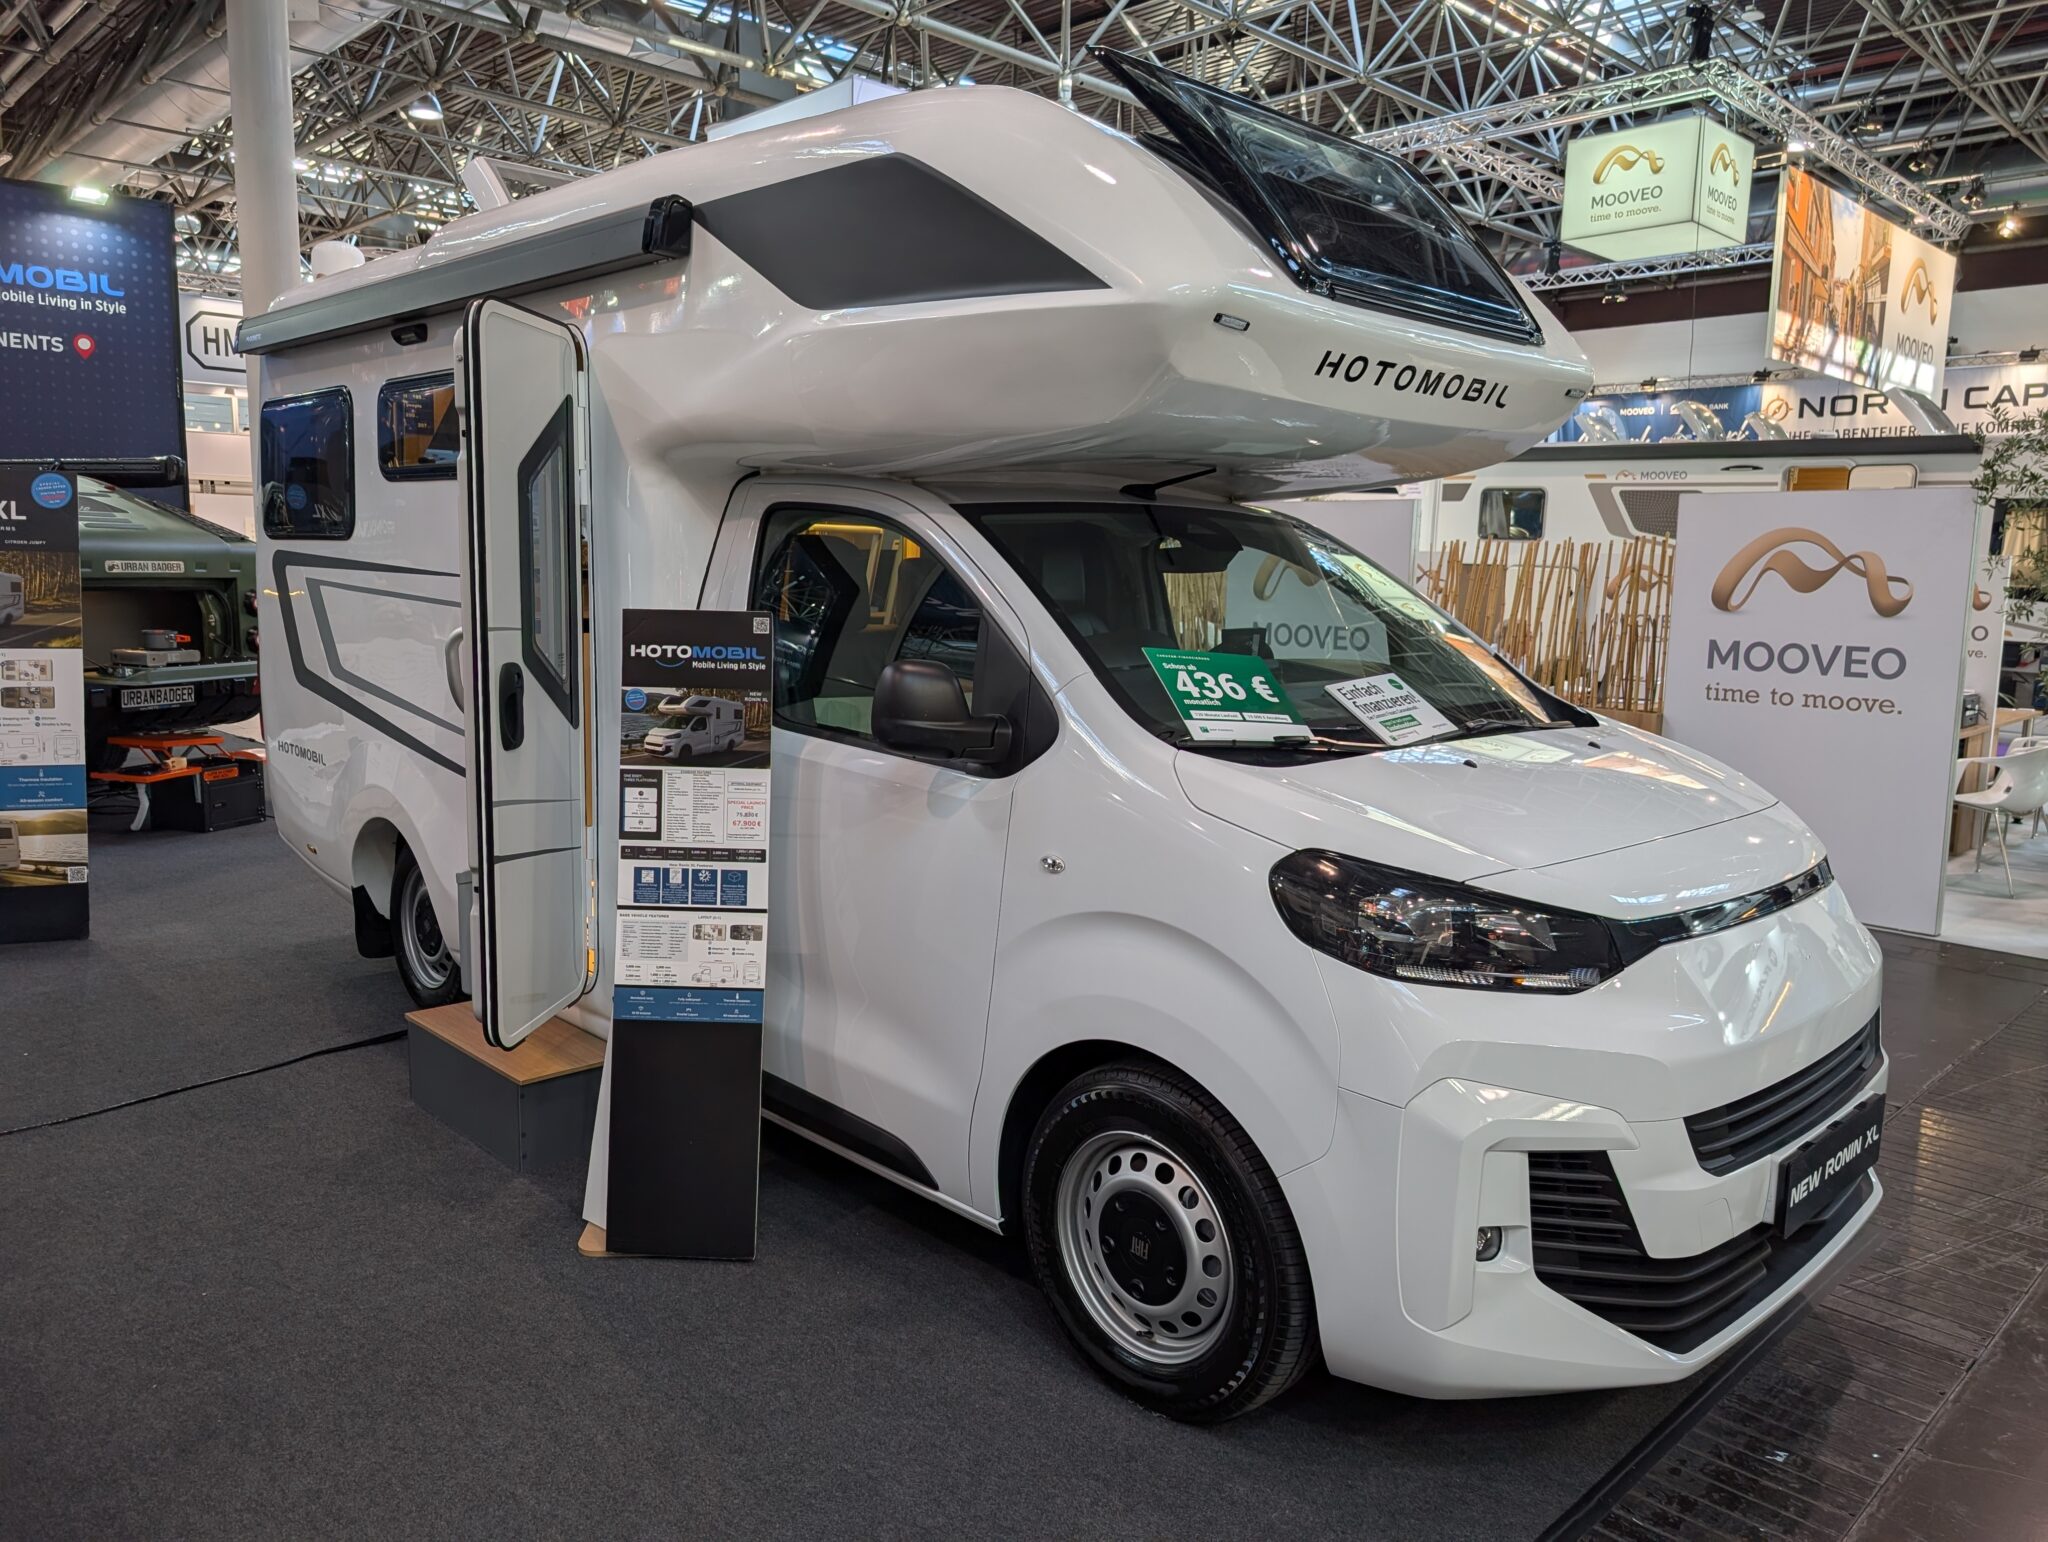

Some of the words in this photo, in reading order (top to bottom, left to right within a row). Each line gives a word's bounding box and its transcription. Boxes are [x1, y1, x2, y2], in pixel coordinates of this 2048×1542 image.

[1591, 185, 1663, 209] MOOVEO
[1707, 185, 1738, 211] MOOVEO
[1590, 211, 1611, 222] time
[1614, 208, 1624, 219] to
[1626, 205, 1662, 217] moove.
[38, 293, 77, 310] Living
[80, 297, 92, 310] in
[95, 300, 127, 315] Style
[1896, 332, 1934, 364] MOOVEO
[1314, 350, 1510, 409] HOTOMOBIL
[1620, 407, 1655, 416] MOOVEO
[1640, 470, 1688, 481] MOOVEO
[120, 562, 149, 572] URBAN
[151, 562, 182, 572] BADGER
[630, 644, 766, 660] HOTOMOBIL
[1707, 639, 1907, 680] MOOVEO
[692, 661, 715, 669] Mobile
[717, 661, 738, 670] Living
[748, 662, 766, 671] Style
[1162, 662, 1187, 670] Schon
[122, 686, 194, 707] URBANBADGER
[1176, 670, 1247, 700] 436
[1251, 675, 1280, 703] €
[1336, 682, 1385, 701] Einfach
[1184, 698, 1221, 706] monatlich
[1352, 691, 1421, 715] finanzieren!
[1705, 682, 1760, 704] time
[1770, 688, 1794, 706] to
[1801, 693, 1902, 715] moove.
[277, 740, 327, 767] HOTOMOBIL
[1790, 1166, 1822, 1208] NEW
[1825, 1136, 1863, 1180] RONIN
[1864, 1124, 1880, 1149] XL
